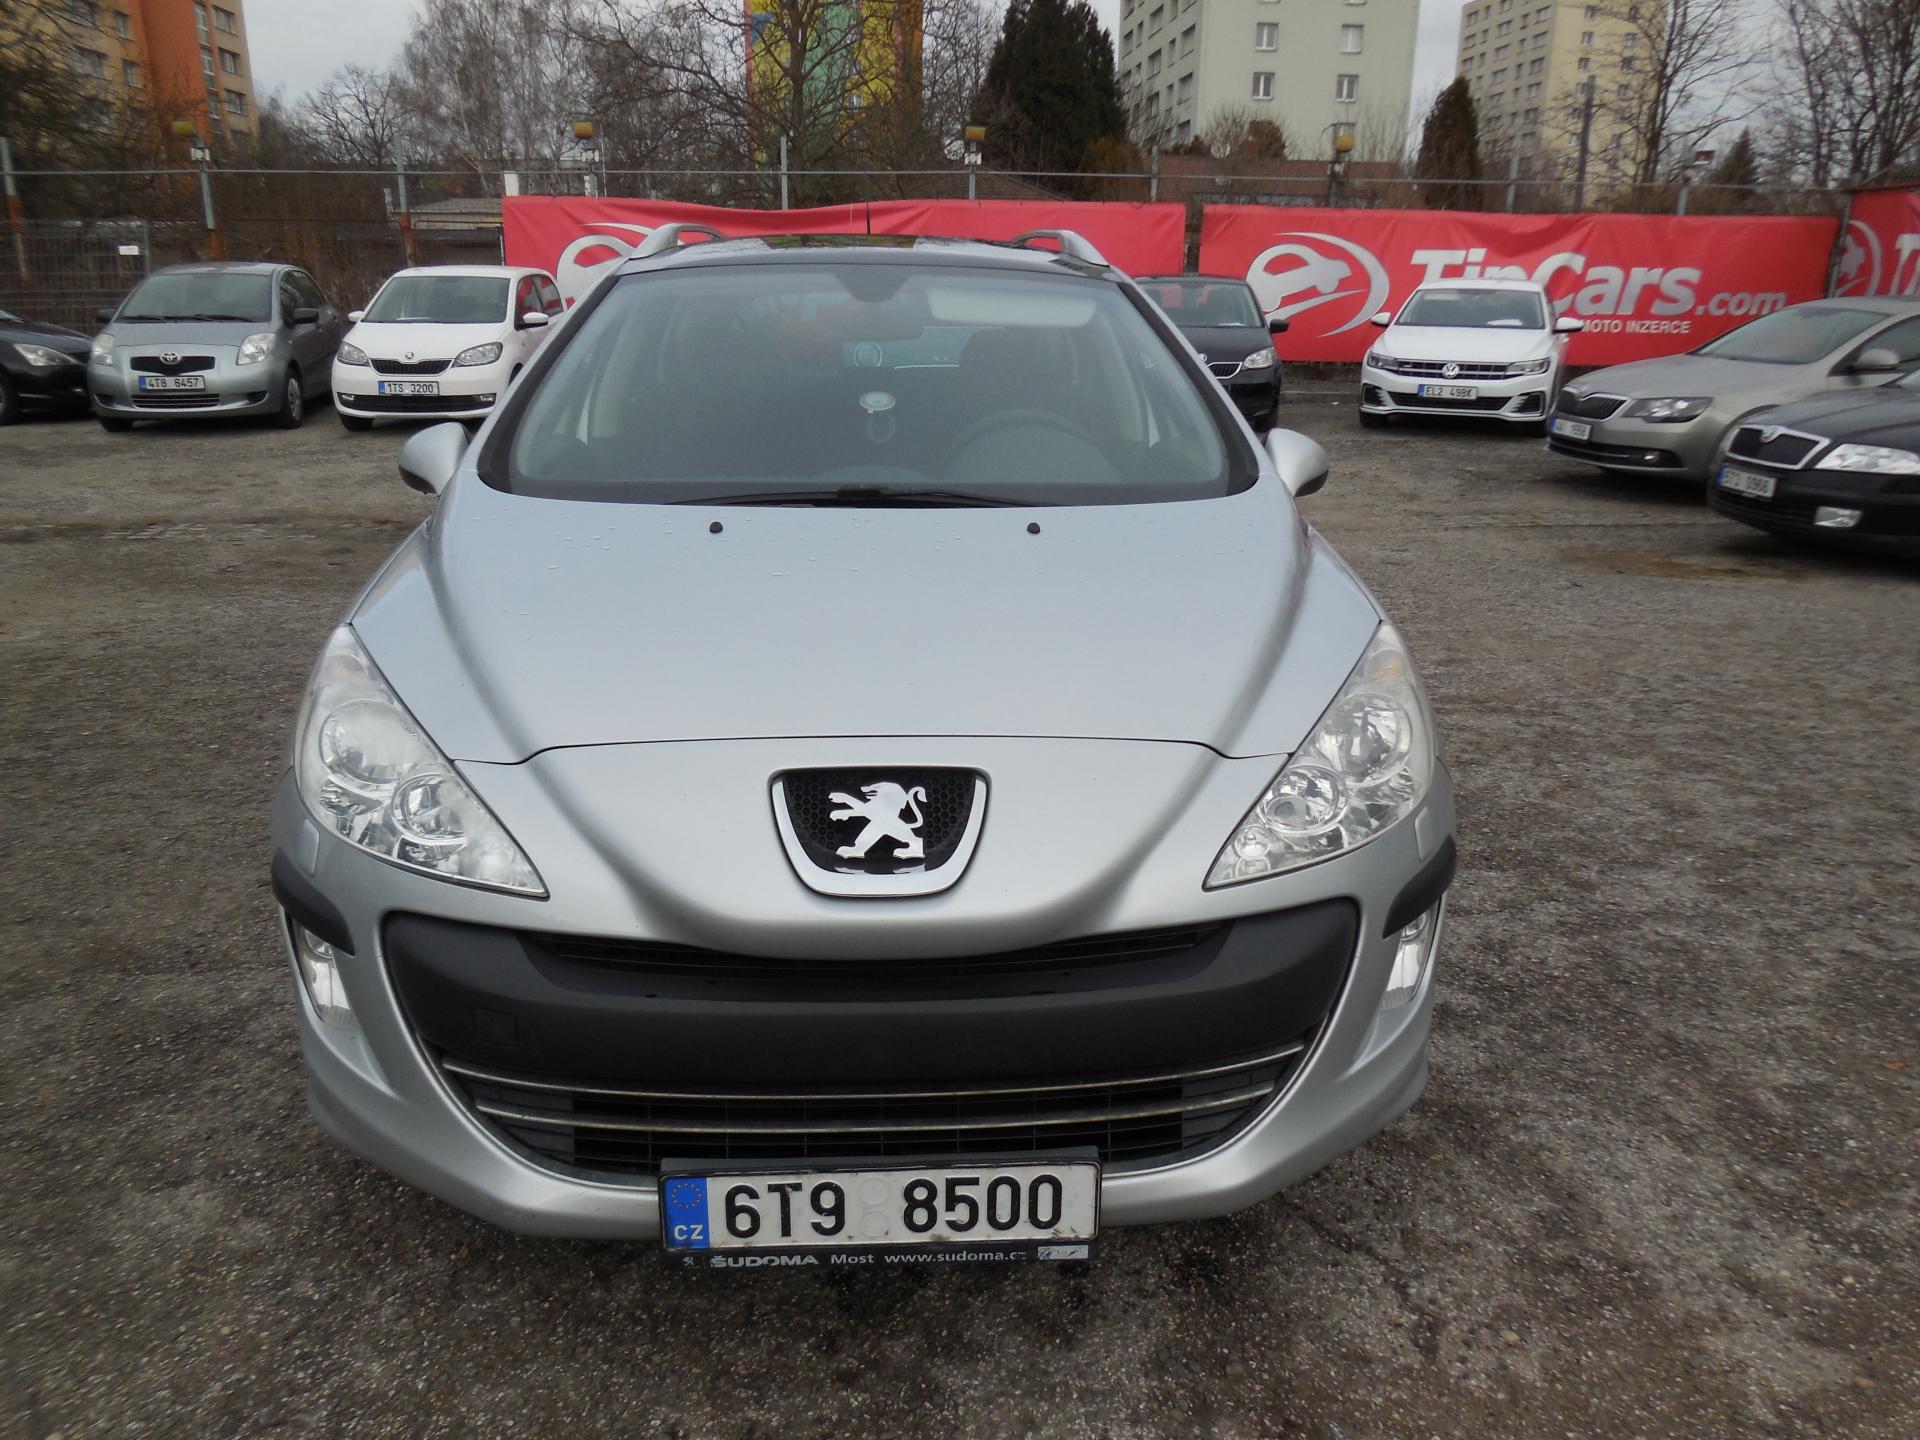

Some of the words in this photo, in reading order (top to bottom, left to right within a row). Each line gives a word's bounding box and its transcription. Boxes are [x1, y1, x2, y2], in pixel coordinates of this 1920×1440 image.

[1411, 248, 1786, 317] TCars.com
[1625, 319, 1692, 334] INZERCE
[174, 377, 199, 388] 6457
[387, 383, 404, 393] 1TS
[410, 383, 434, 394] 3200
[724, 1181, 846, 1239] 6T9
[903, 1174, 1063, 1234] 8500
[673, 1224, 704, 1241] CZ
[830, 1253, 875, 1265] Most
